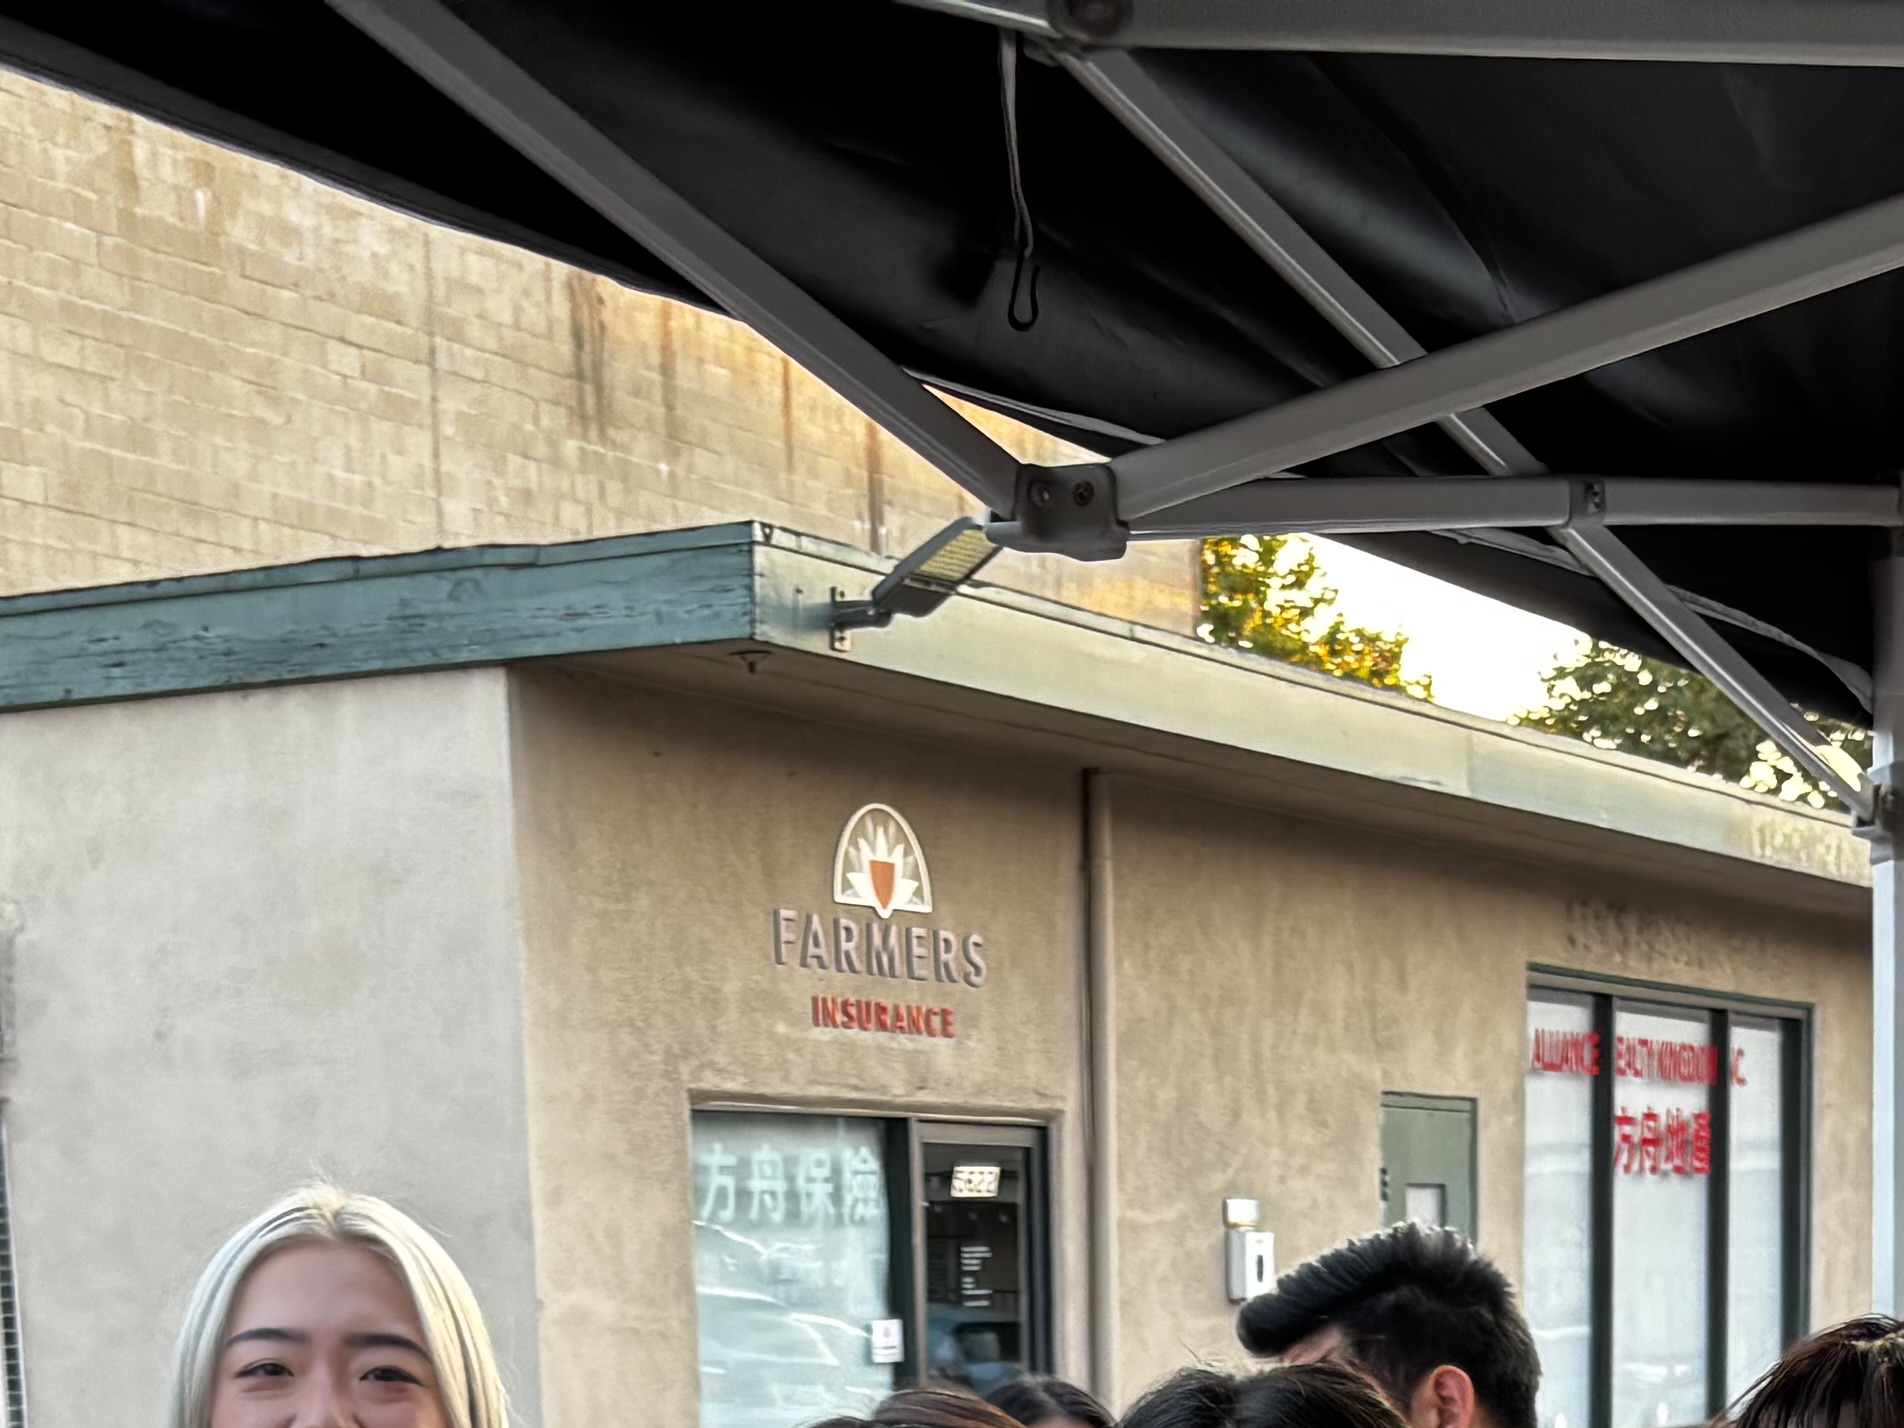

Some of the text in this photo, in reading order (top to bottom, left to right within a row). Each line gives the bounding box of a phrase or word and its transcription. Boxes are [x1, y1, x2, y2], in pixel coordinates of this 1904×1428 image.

[774, 909, 987, 988] FARMERS
[811, 995, 955, 1038] INSURANCE
[1615, 1036, 1656, 1080] EALTY
